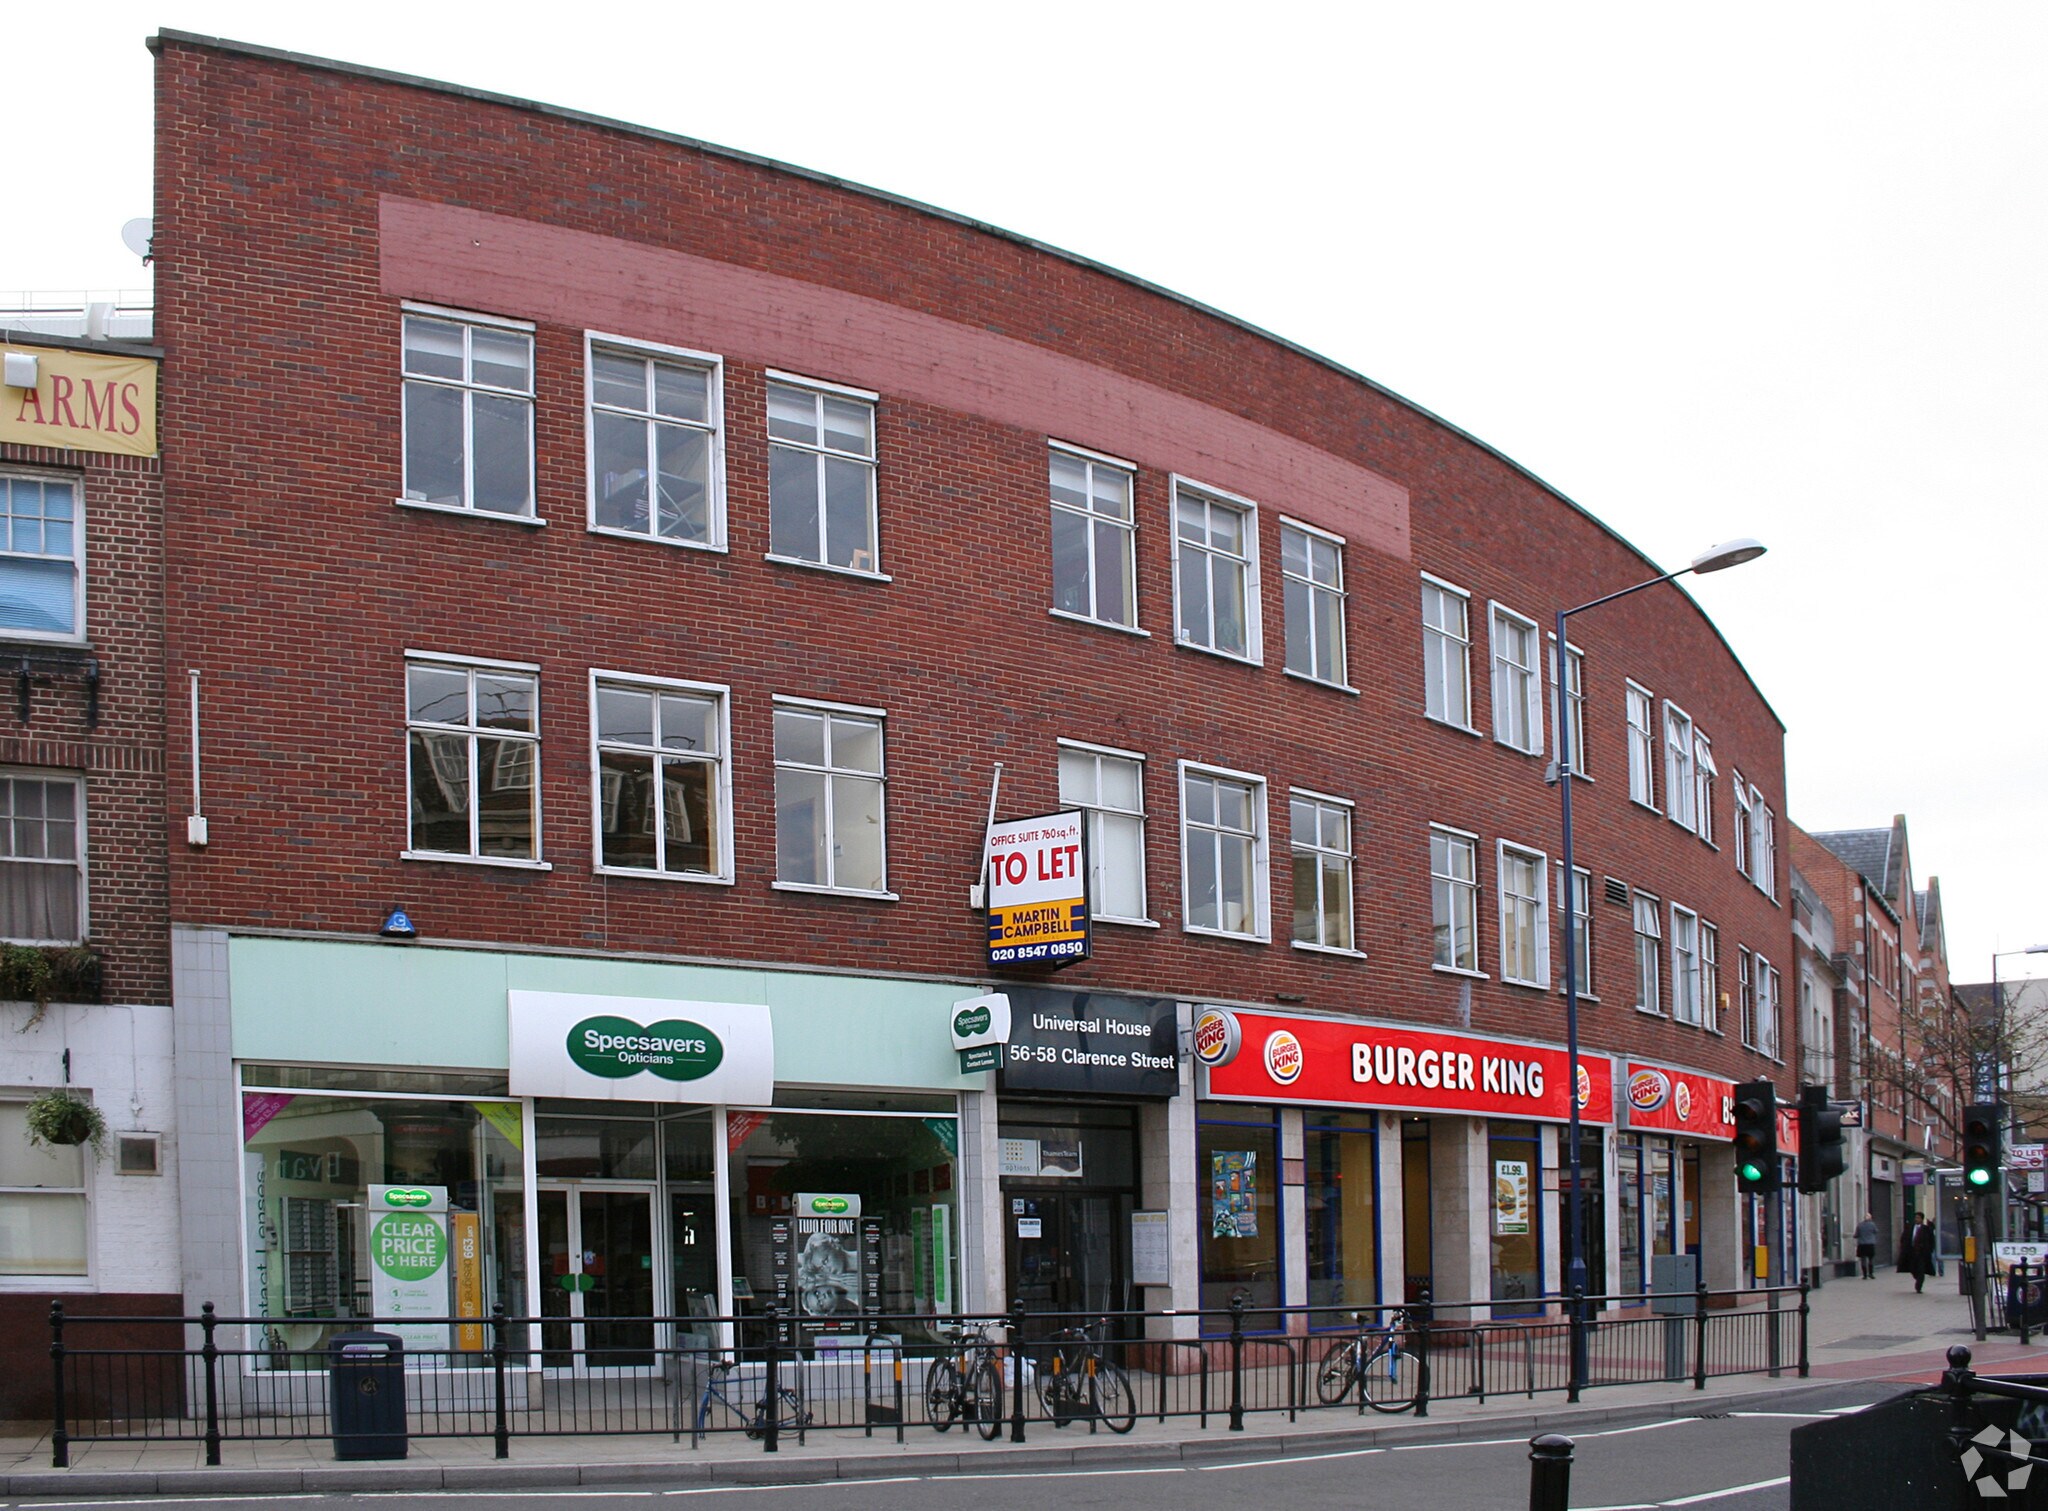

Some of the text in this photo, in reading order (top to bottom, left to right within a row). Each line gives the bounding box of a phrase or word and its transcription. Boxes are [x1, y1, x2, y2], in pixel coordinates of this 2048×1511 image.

[16, 374, 140, 435] ARMS
[991, 833, 1016, 846] OFFICE
[1018, 831, 1039, 843] SUITE
[991, 845, 1079, 886] TO LET
[1012, 907, 1060, 925] MARTIN
[1003, 920, 1070, 939] CAMPBELL
[992, 942, 1083, 961] 020 8547 0850
[957, 1013, 988, 1027] Specsavers
[1033, 1013, 1151, 1037] Universal House
[1195, 1019, 1223, 1041] BURGER
[584, 1029, 706, 1053] Specsavers
[1197, 1028, 1225, 1053] KING
[618, 1051, 674, 1065] Opticians
[1010, 1044, 1174, 1069] 56-58 Clarence Street
[1272, 1042, 1297, 1058] BURGER
[1273, 1051, 1299, 1070] KING
[1352, 1042, 1544, 1098] BURGER KING
[1630, 1077, 1660, 1094] BURGER
[1632, 1084, 1661, 1102] KING
[1005, 1164, 1031, 1172] options
[1502, 1165, 1521, 1175] £1.99
[388, 1192, 427, 1200] Specsavers
[381, 1222, 435, 1237] CLEAR
[799, 1219, 819, 1234] TWO
[820, 1219, 838, 1234] FOR
[838, 1219, 854, 1234] ONE
[381, 1237, 437, 1254] PRICE
[2002, 1246, 2037, 1257] £1.99
[382, 1255, 437, 1267] IS HERE
[463, 1301, 475, 1340] glases
